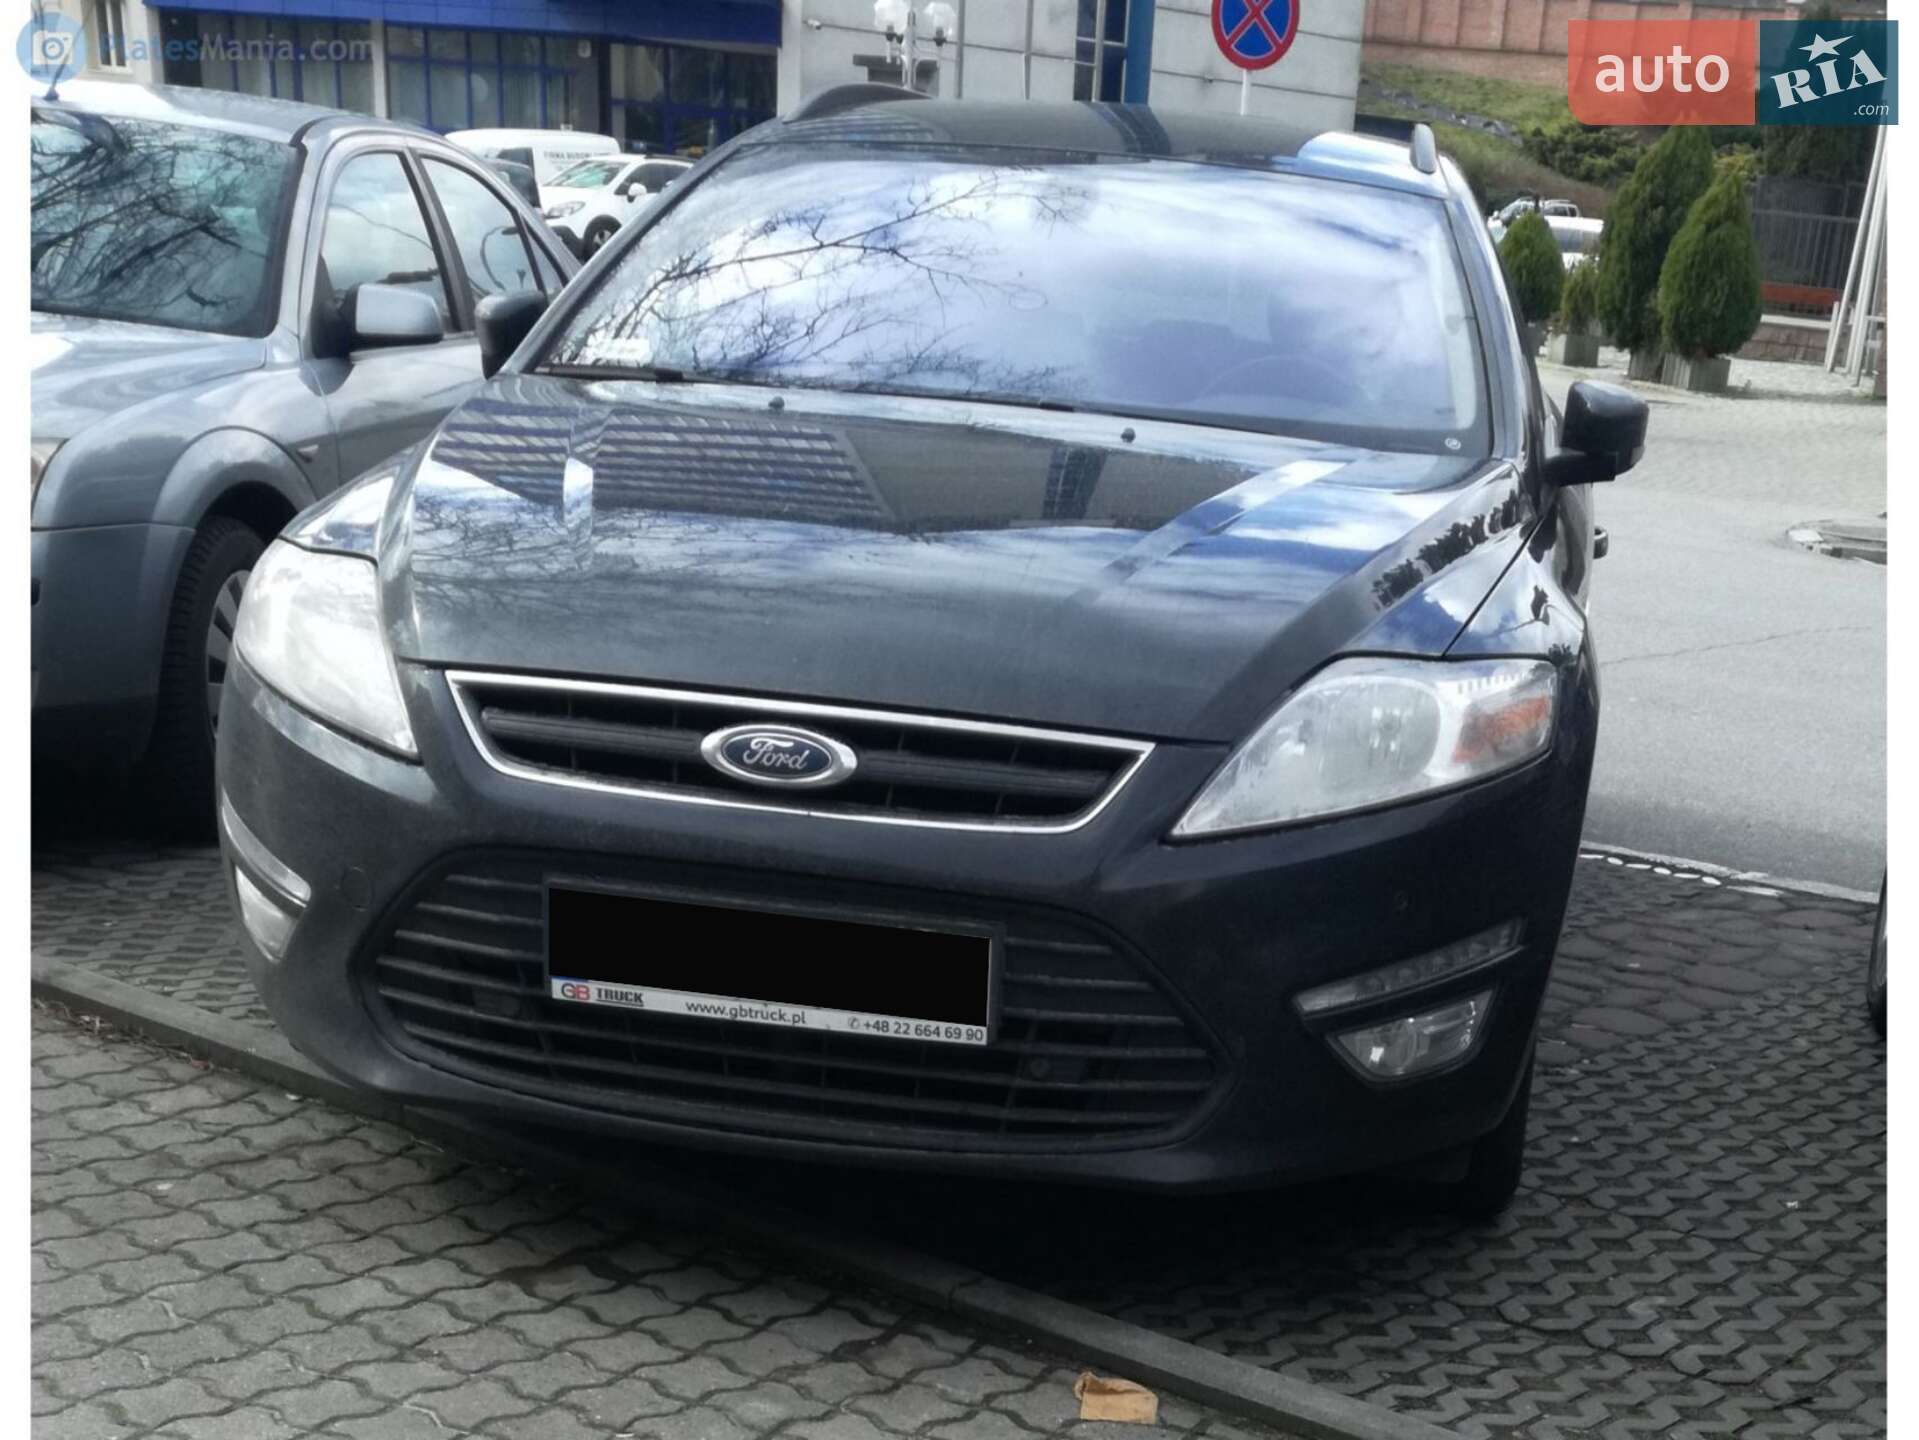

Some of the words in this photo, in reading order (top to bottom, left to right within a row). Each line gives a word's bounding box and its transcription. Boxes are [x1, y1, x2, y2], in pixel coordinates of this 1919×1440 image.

[743, 737, 810, 769] Ford
[561, 982, 590, 1000] GB
[596, 987, 643, 1006] TRUCK
[686, 1001, 806, 1025] www.gbtruck.pl
[863, 1019, 889, 1033] +48
[893, 1022, 910, 1036] 22
[914, 1025, 940, 1038] 664
[944, 1027, 962, 1040] 69
[965, 1029, 984, 1042] 90
